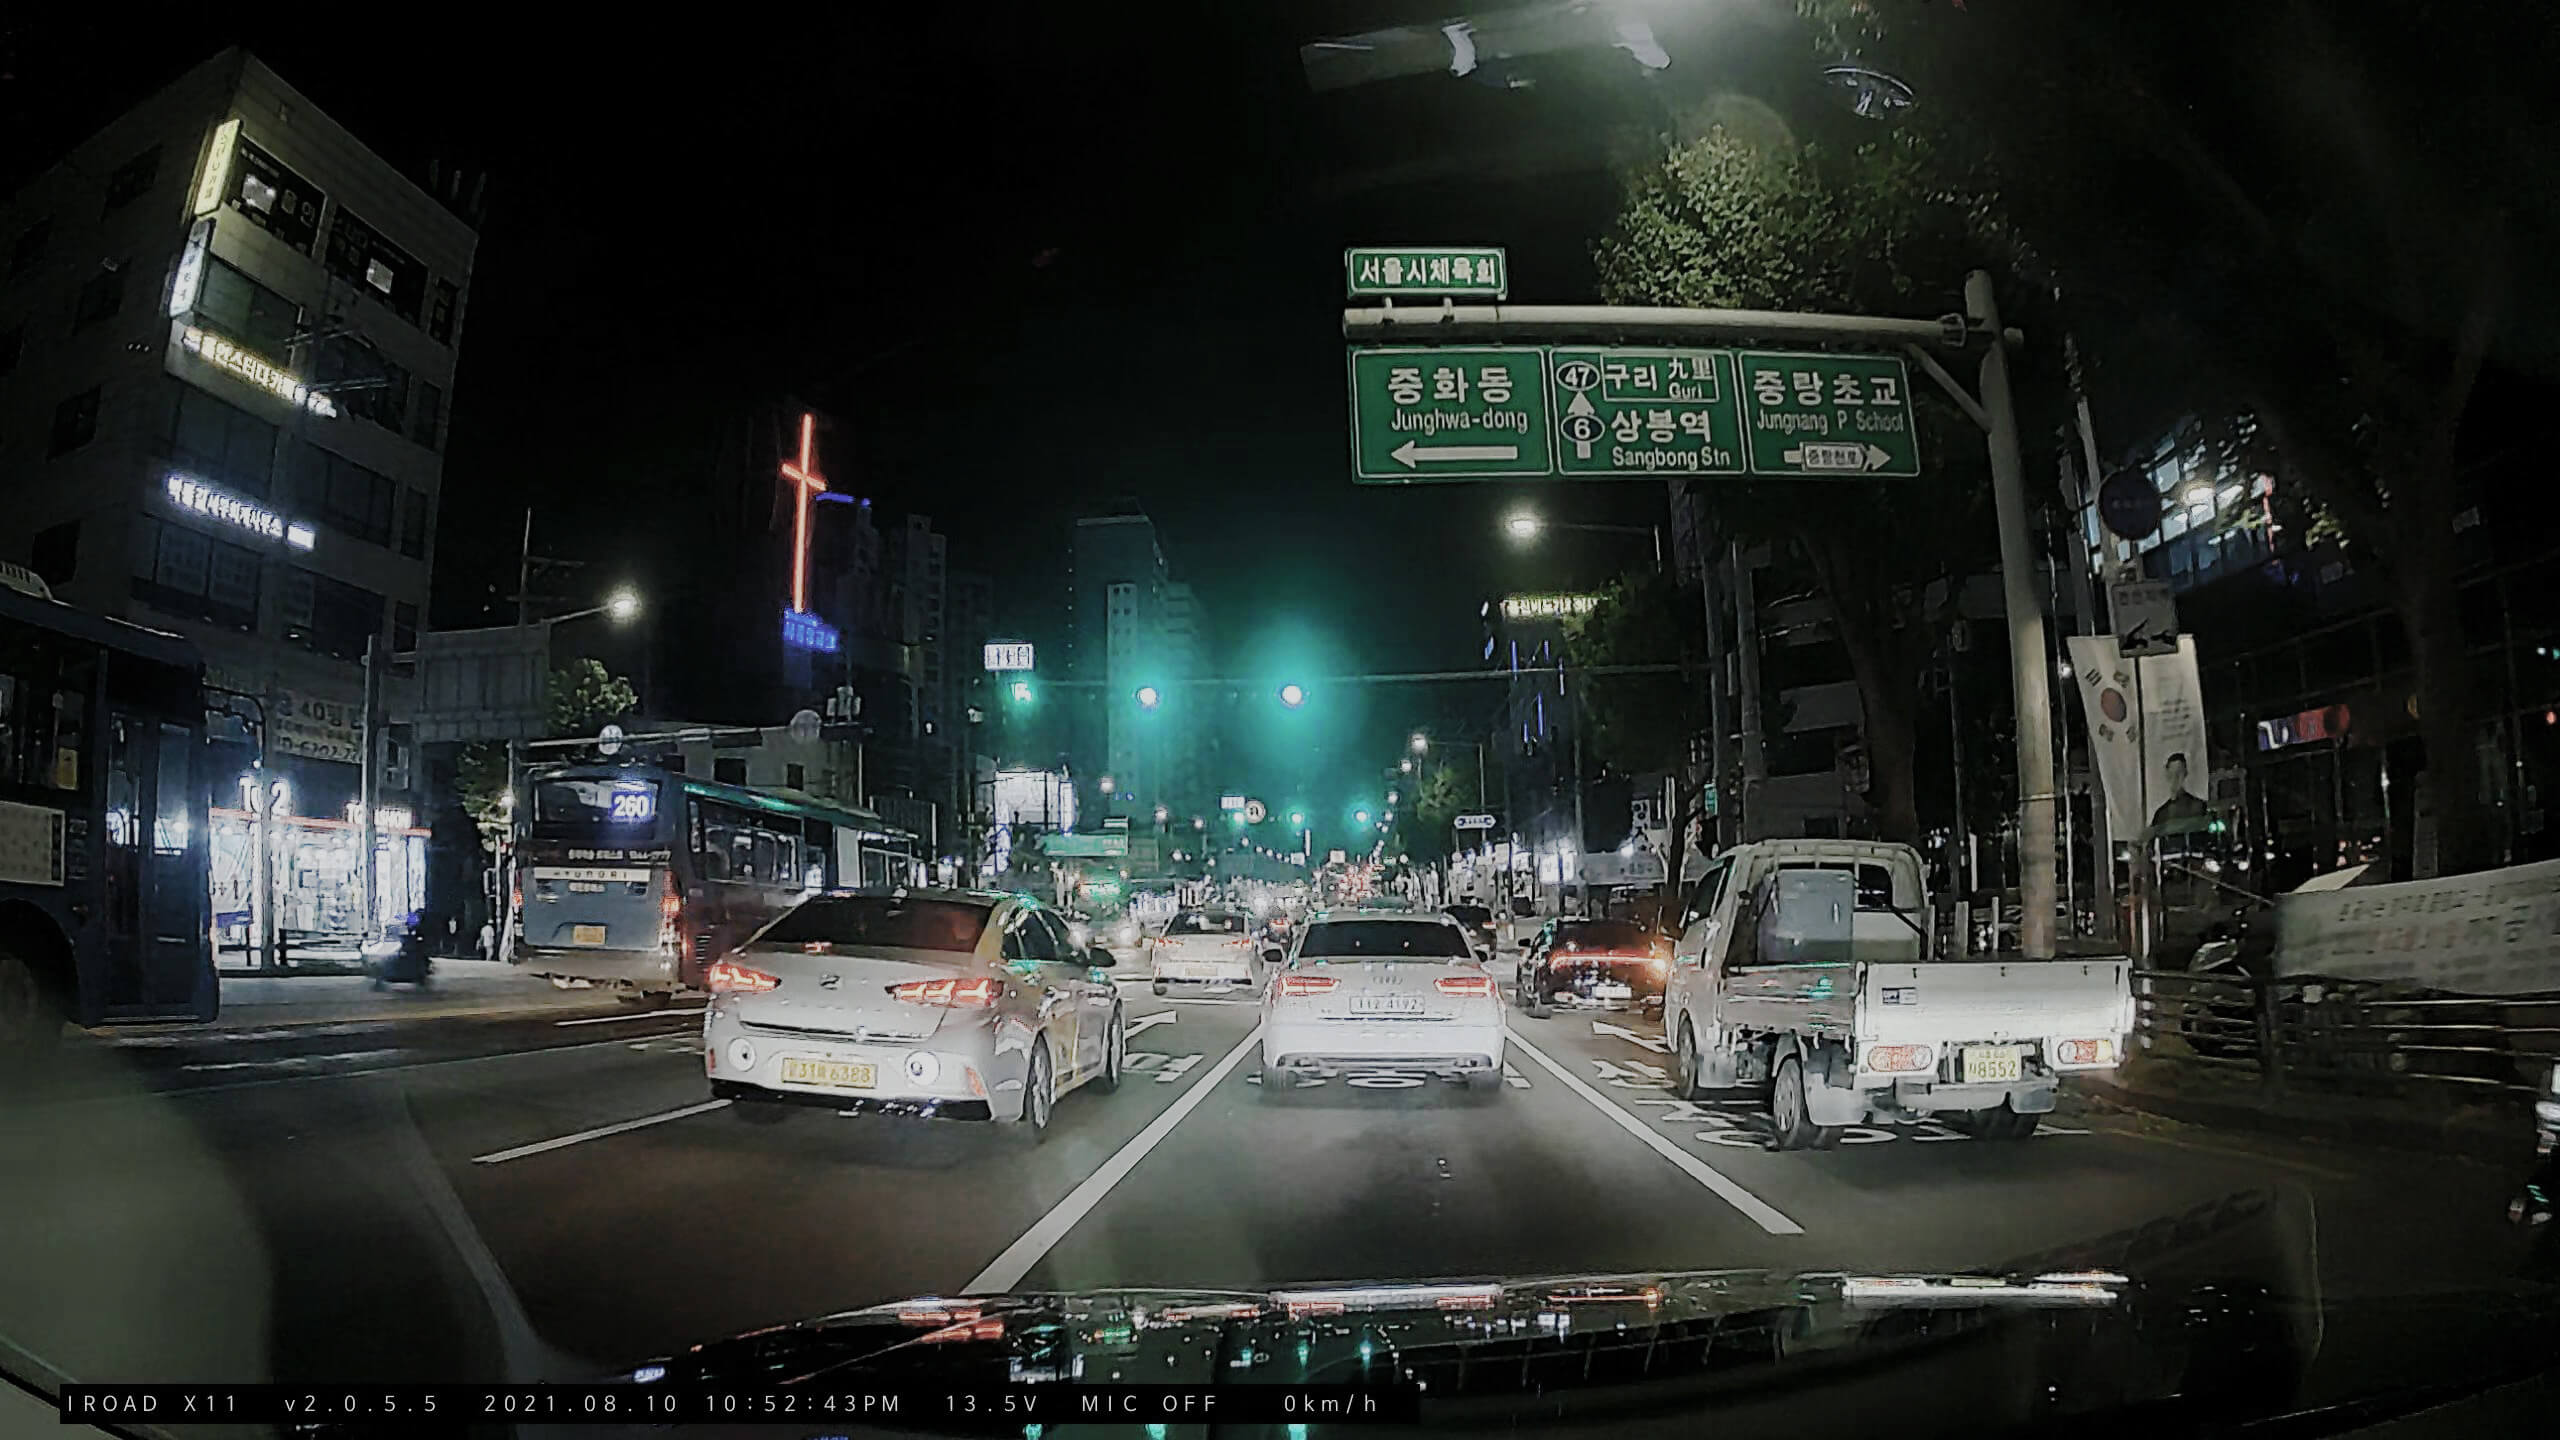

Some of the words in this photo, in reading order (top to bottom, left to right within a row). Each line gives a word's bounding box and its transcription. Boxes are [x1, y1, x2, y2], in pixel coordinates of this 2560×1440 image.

[1359, 256, 1495, 285] 서울시체육회
[1388, 367, 1512, 404] 중화동
[1564, 366, 1590, 387] 47
[1604, 363, 1658, 392] 구리
[1753, 370, 1901, 406] 중랑초교
[1668, 382, 1702, 400] Guri
[1391, 407, 1528, 435] Junghwa-dong
[1573, 418, 1591, 439] 6
[1610, 409, 1711, 443] 상봉역
[1756, 408, 1829, 436] Jungnang
[1836, 410, 1848, 430] P
[1855, 409, 1904, 432] School
[1612, 446, 1698, 471] Sangbong
[1700, 446, 1731, 466] Stn
[613, 794, 649, 817] 260
